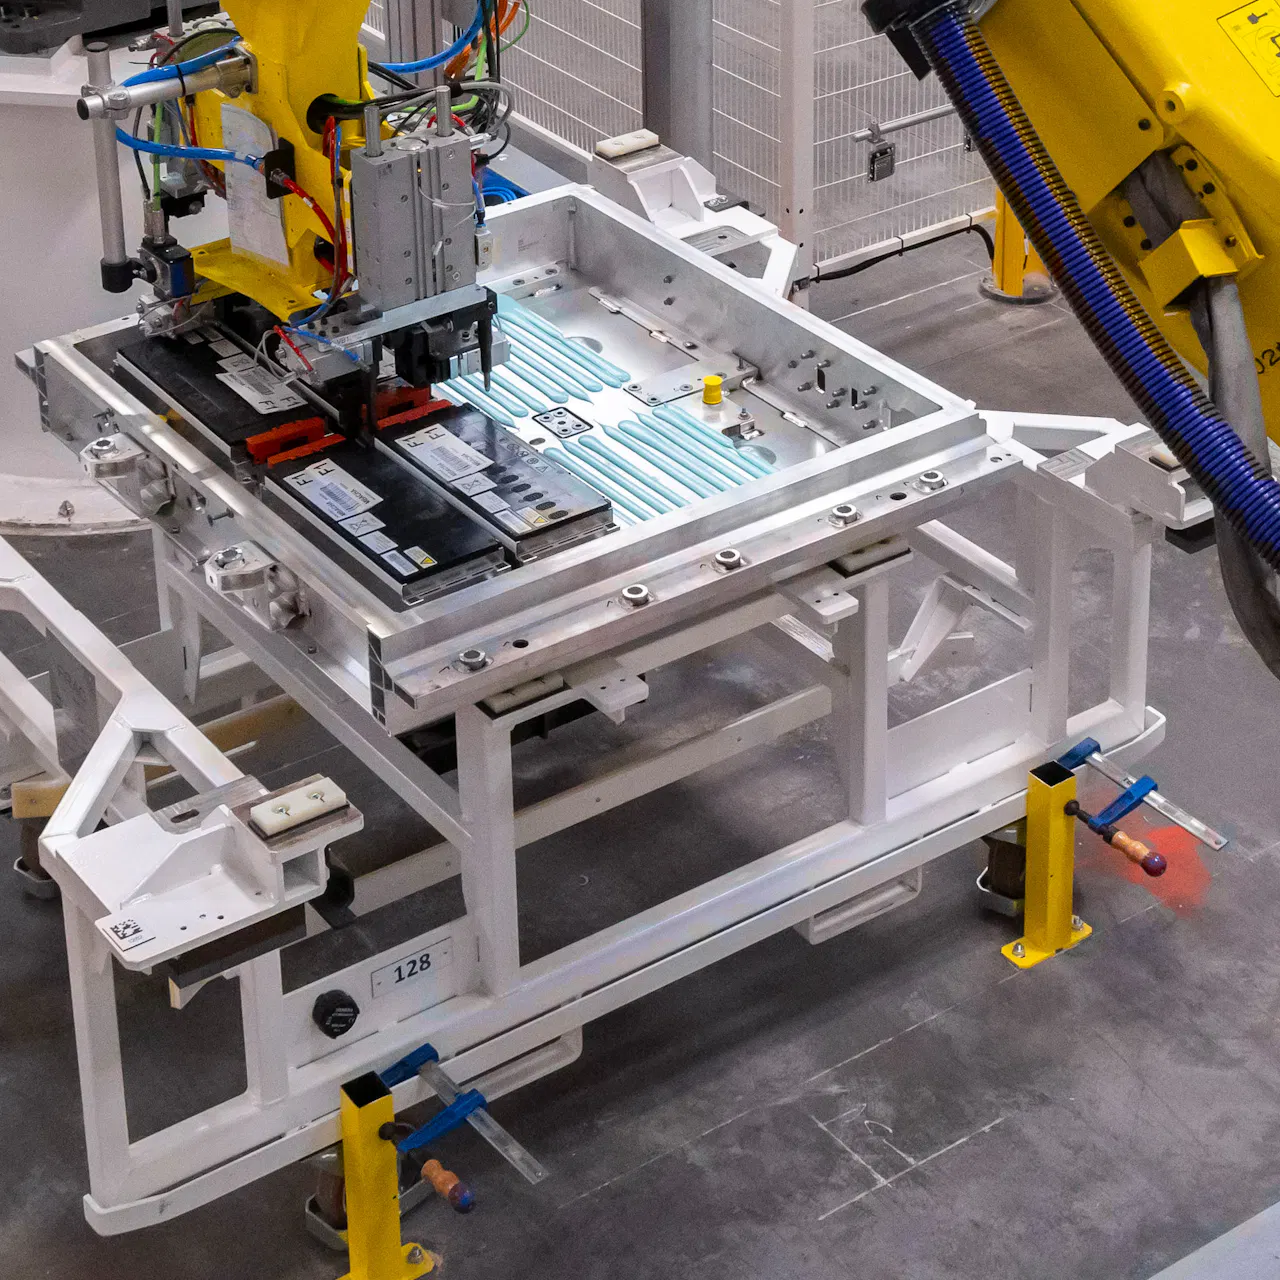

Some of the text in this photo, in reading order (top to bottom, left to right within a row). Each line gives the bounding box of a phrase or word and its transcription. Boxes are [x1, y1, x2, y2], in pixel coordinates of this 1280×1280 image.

[424, 427, 446, 441] F1
[402, 436, 424, 448] F1
[314, 462, 335, 477] F1
[291, 473, 314, 487] F1
[394, 953, 431, 984] 128
